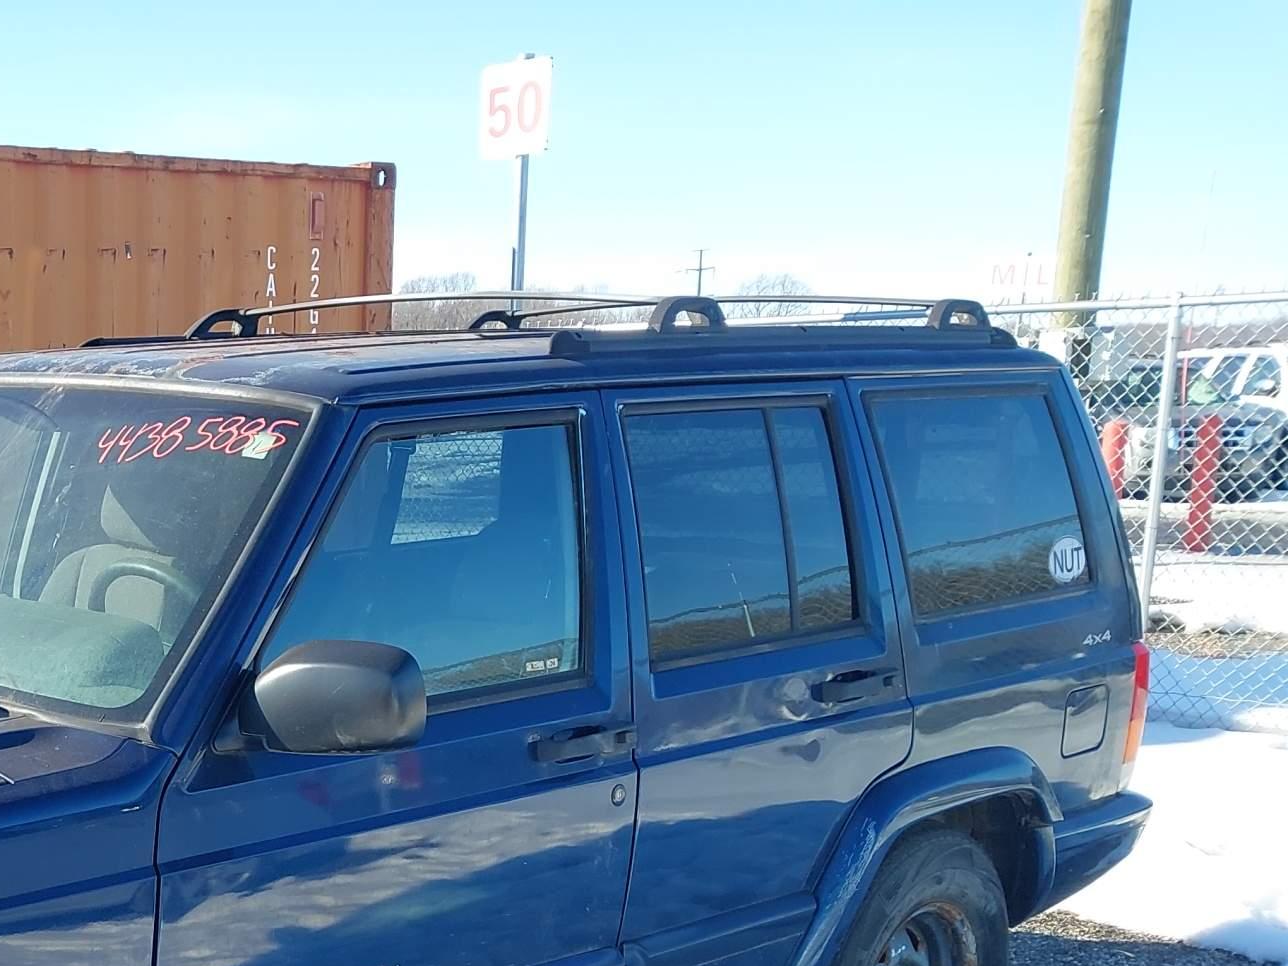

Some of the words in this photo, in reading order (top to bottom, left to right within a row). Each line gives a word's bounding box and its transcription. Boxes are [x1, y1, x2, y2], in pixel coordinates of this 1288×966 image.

[488, 81, 542, 138] 50
[265, 246, 277, 335] CAI
[310, 247, 320, 335] 22G
[1053, 546, 1082, 575] NUT
